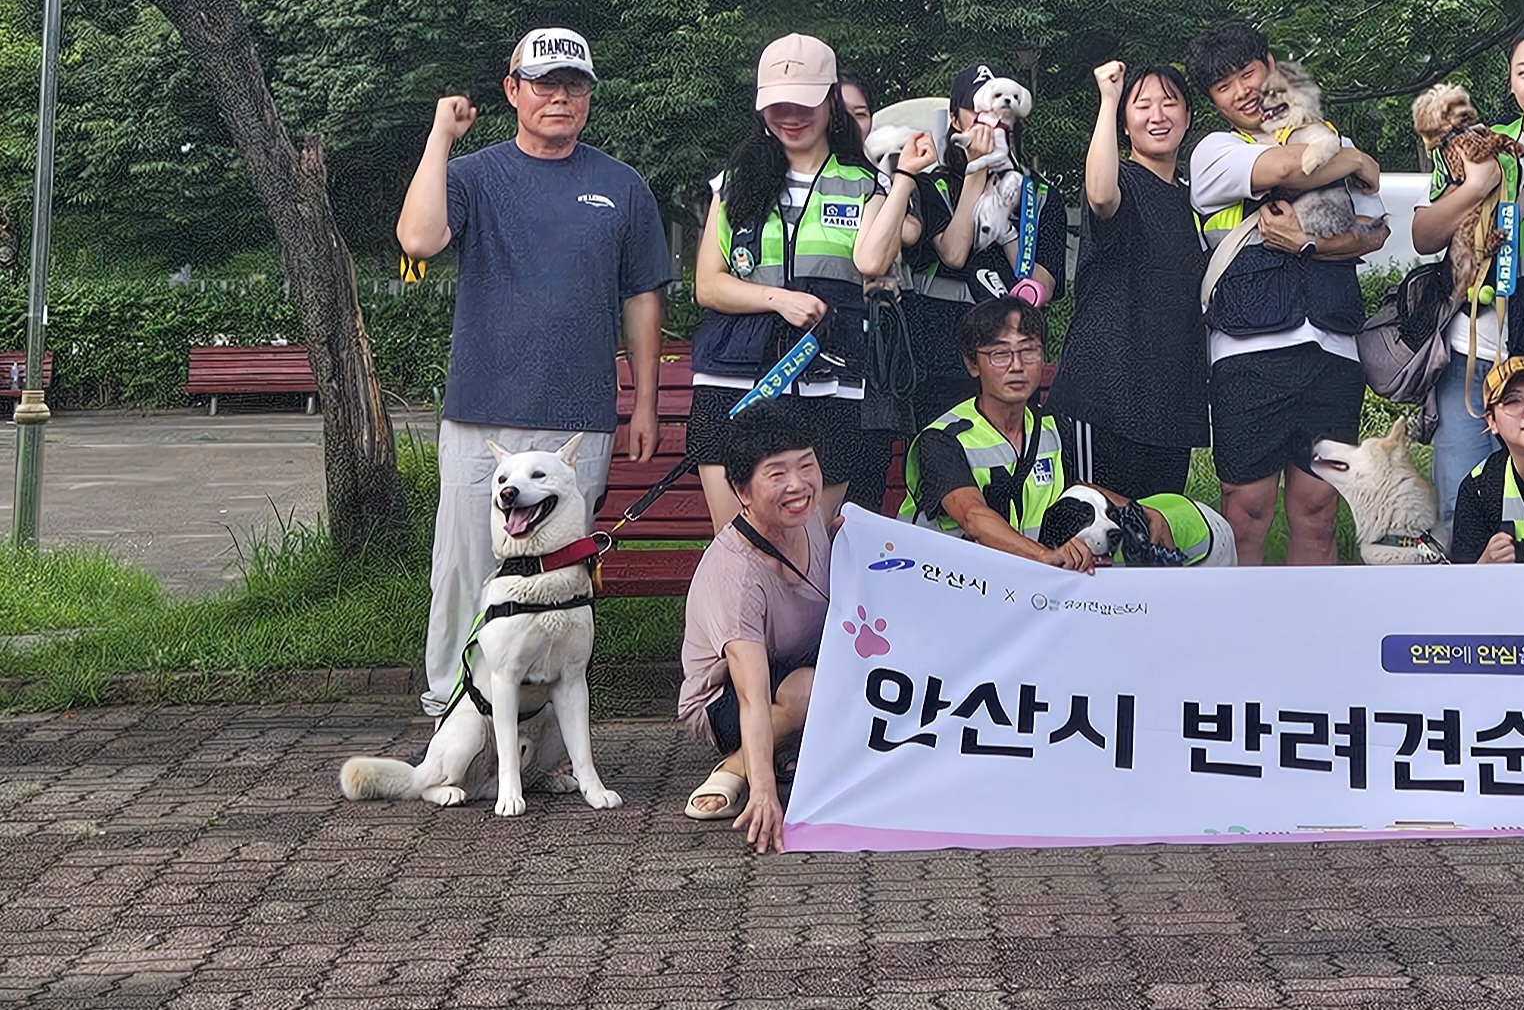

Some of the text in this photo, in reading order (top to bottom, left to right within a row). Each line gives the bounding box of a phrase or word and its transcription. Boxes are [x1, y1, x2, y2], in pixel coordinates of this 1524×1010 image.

[920, 564, 987, 596] 안산시
[1410, 644, 1472, 664] 안전에
[865, 667, 1135, 770] 안산시
